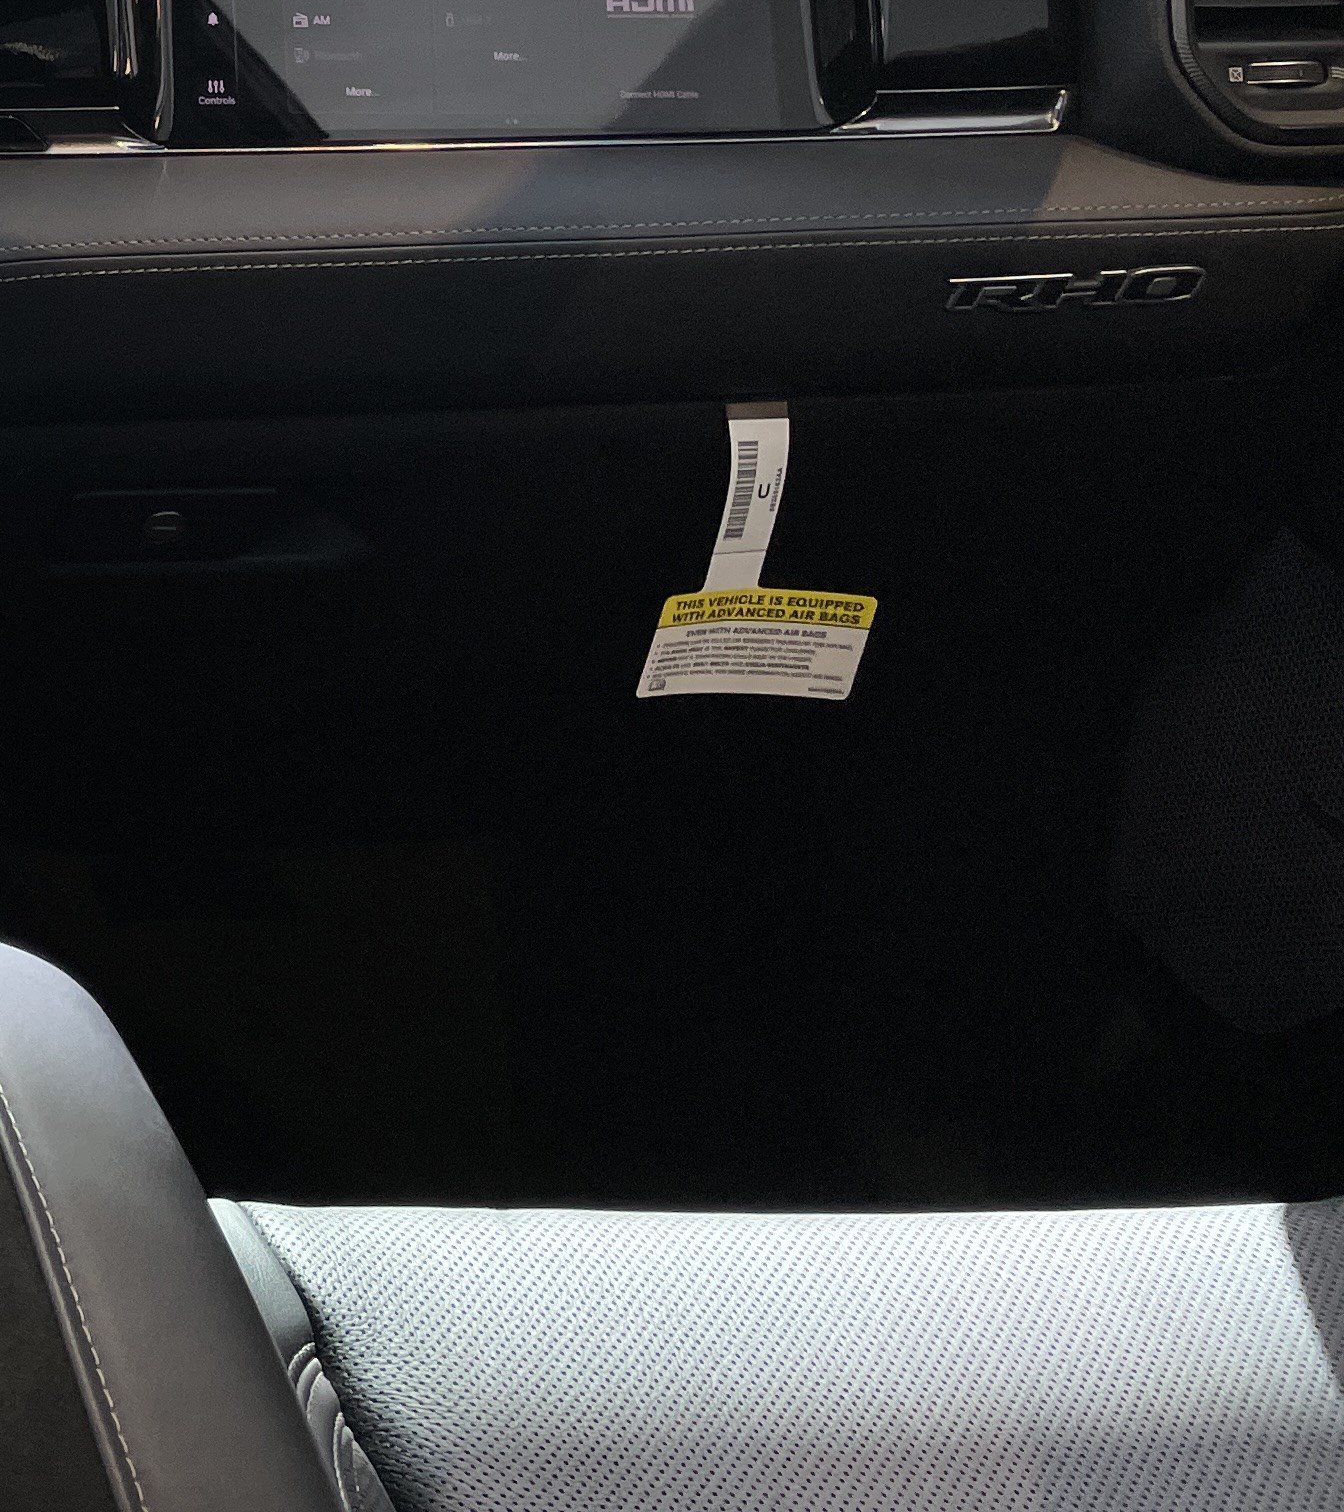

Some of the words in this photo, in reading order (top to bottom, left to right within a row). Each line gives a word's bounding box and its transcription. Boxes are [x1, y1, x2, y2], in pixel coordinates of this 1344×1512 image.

[313, 15, 331, 26] AM
[198, 95, 237, 107] Controls
[945, 264, 1207, 313] RHO
[676, 599, 705, 611] THIS
[708, 594, 765, 607] VEHICLE
[769, 595, 784, 606] IS
[787, 597, 865, 613] EQUIPPED
[672, 612, 705, 624] WITH
[707, 607, 786, 619] ADVANCED
[789, 610, 816, 620] AIR
[819, 613, 861, 625] BAGS
[710, 626, 732, 635] WITH
[732, 626, 782, 637] ADVANCED
[783, 627, 800, 637] AIR
[801, 628, 828, 639] BAGS
